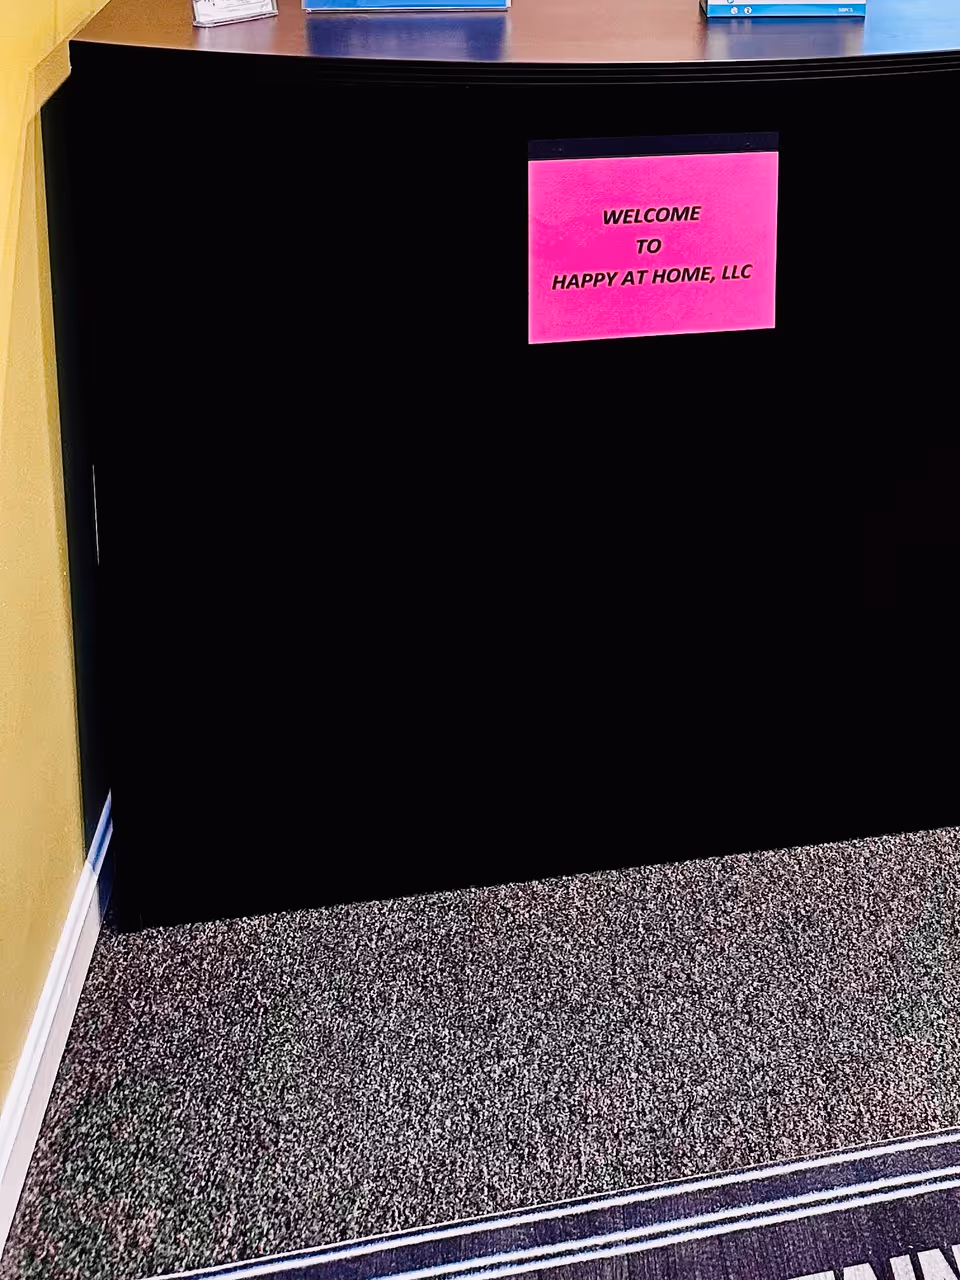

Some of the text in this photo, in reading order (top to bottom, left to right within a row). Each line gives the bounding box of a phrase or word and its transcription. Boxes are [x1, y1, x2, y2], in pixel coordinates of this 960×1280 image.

[603, 205, 702, 225] WELCOME
[636, 238, 662, 255] TO
[551, 263, 754, 290] HAPPY AT HOME, LLC
